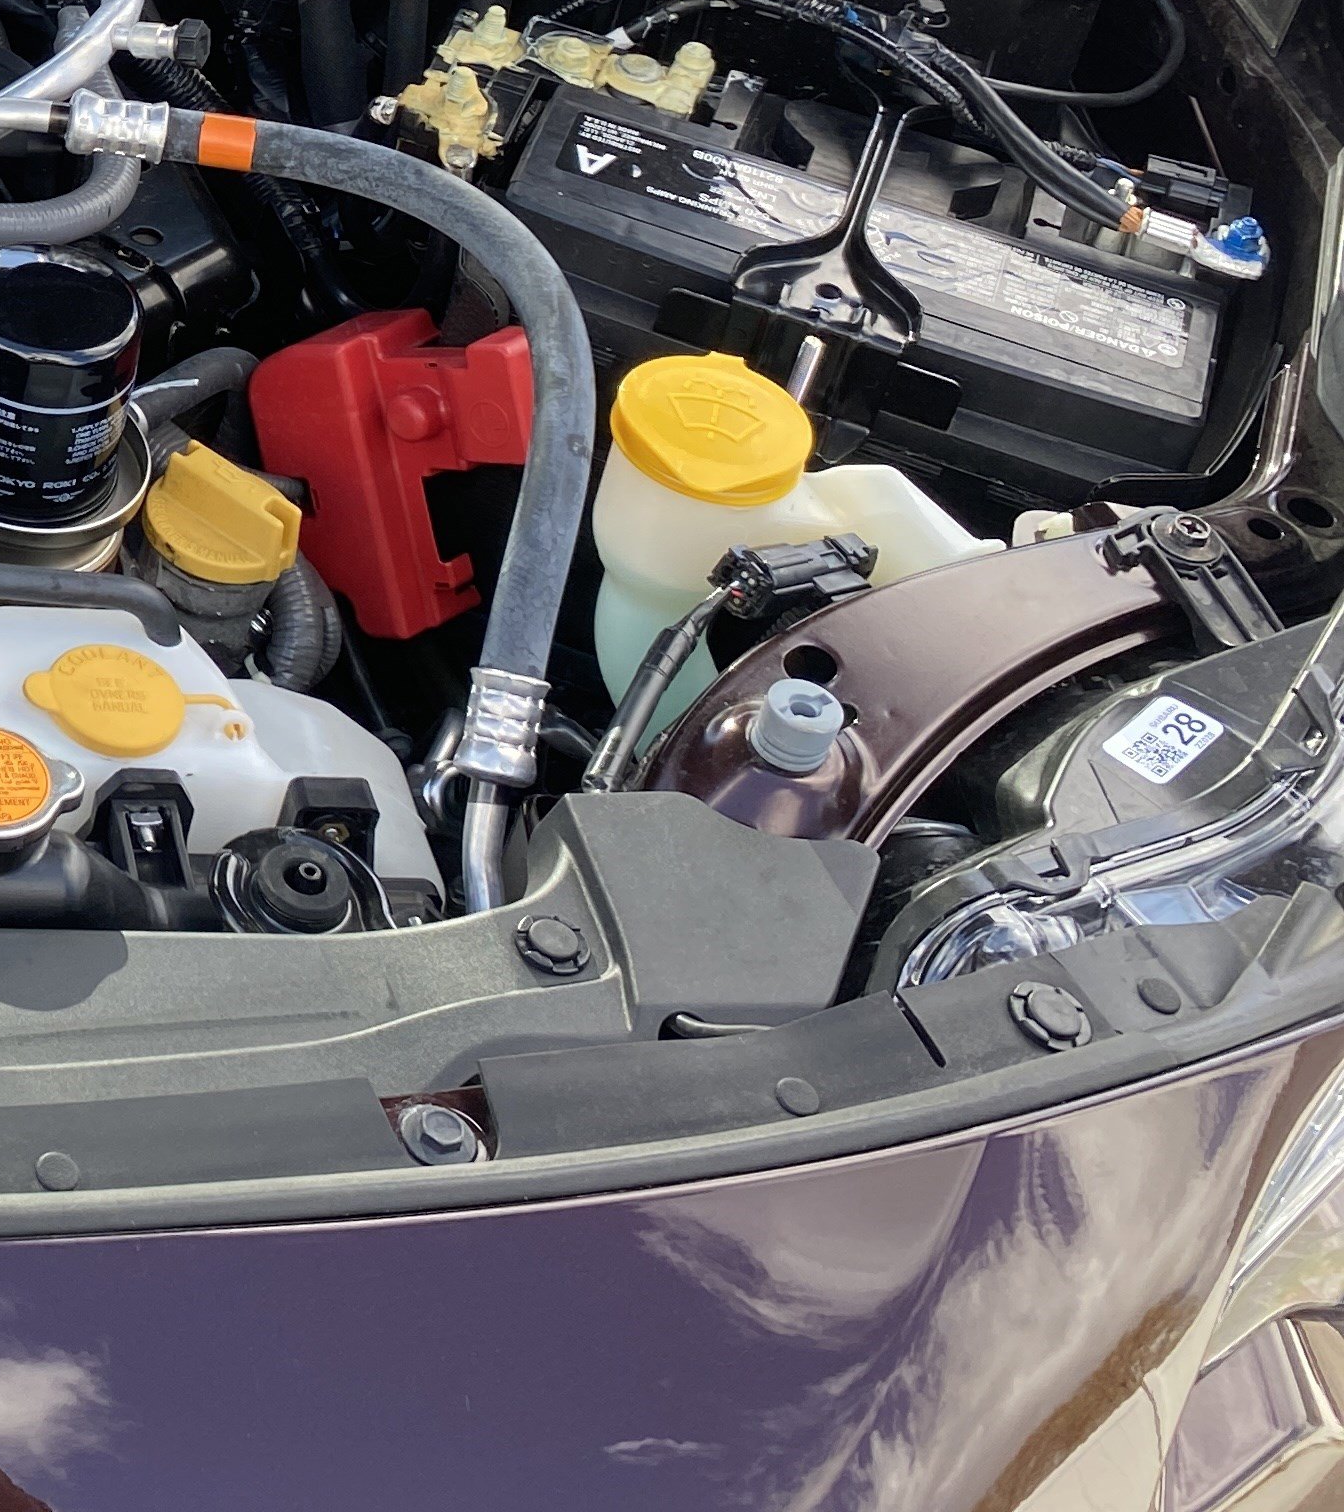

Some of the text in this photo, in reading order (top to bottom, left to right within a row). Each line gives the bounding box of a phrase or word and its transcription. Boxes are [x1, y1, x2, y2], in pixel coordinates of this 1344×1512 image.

[574, 143, 618, 176] A
[646, 185, 679, 201] AMPS
[698, 192, 742, 213] AMPS
[678, 196, 737, 219] CRANKING
[1011, 305, 1140, 356] DANGER/POISON
[42, 478, 77, 490] ROKI
[58, 646, 165, 678] COOLANT
[1149, 704, 1179, 729] SUBARU
[1162, 712, 1207, 746] 28
